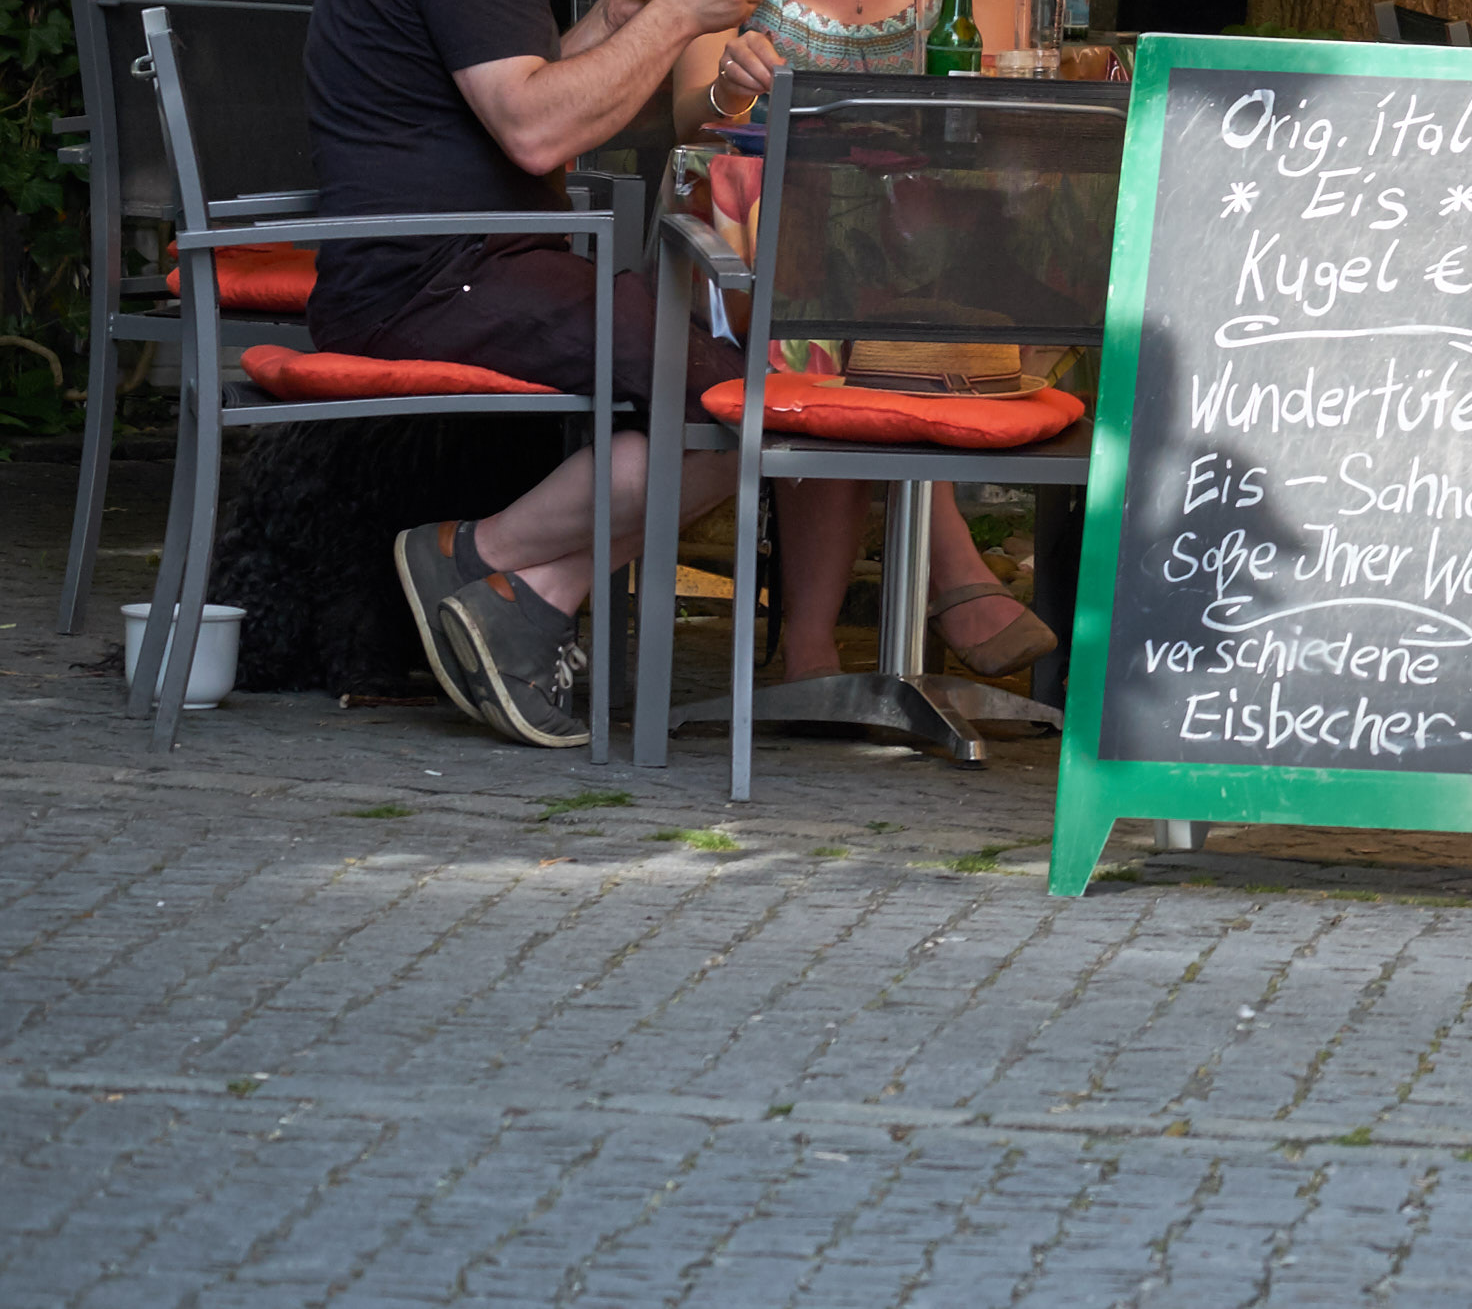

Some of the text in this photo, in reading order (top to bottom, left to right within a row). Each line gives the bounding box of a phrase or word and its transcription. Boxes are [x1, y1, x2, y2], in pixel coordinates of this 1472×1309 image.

[1301, 167, 1409, 231] Eis
[1235, 229, 1399, 317] Kugel
[1182, 453, 1267, 516] Eis
[1163, 529, 1277, 600] Soße
[1144, 627, 1442, 685] verschiedene
